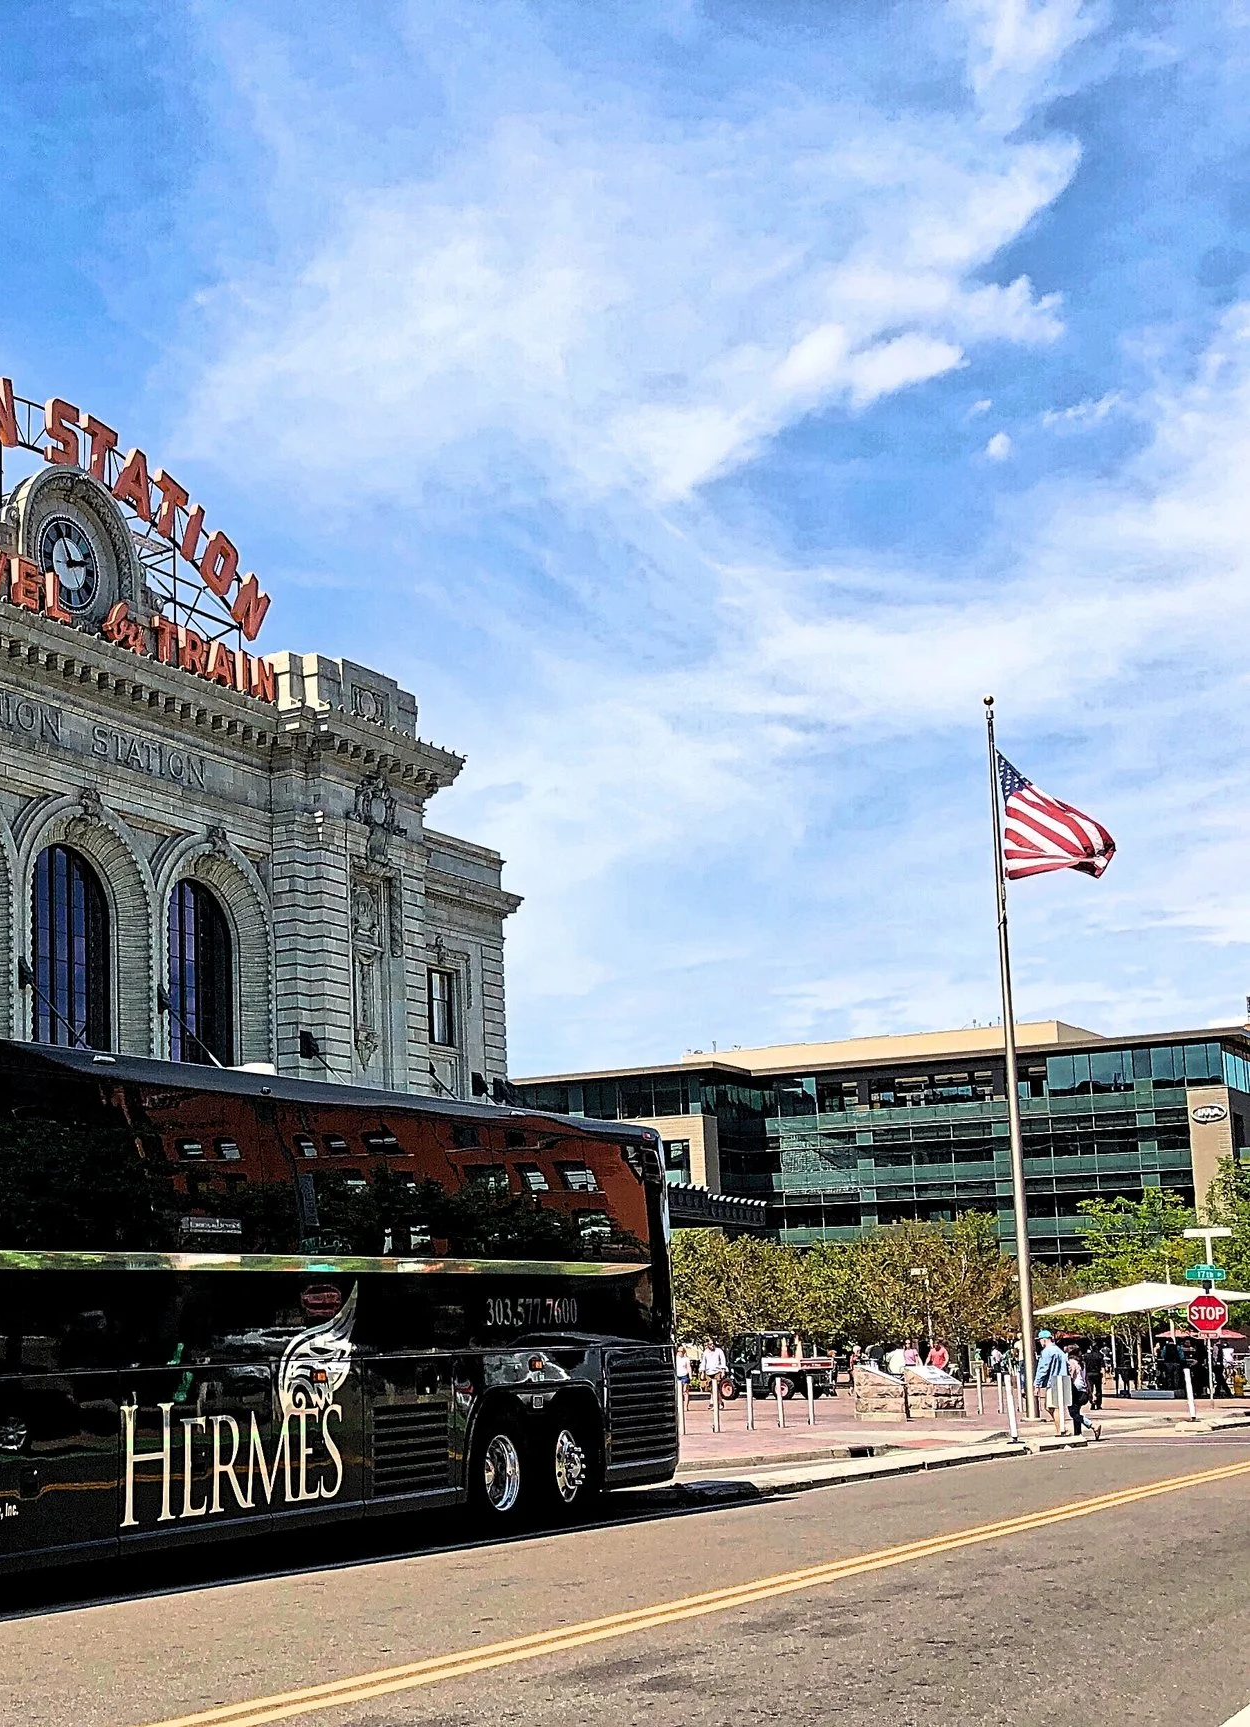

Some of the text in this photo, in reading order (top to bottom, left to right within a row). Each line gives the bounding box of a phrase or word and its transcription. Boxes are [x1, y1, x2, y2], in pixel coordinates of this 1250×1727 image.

[44, 398, 271, 642] STATION
[151, 614, 277, 705] TRAIN
[91, 725, 206, 790] STATION
[1197, 1270, 1214, 1278] 17th
[486, 1298, 578, 1327] 303.577.7600
[1190, 1306, 1225, 1320] STOP
[120, 1402, 343, 1527] HERMES
[5, 1502, 19, 1517] Inc.
